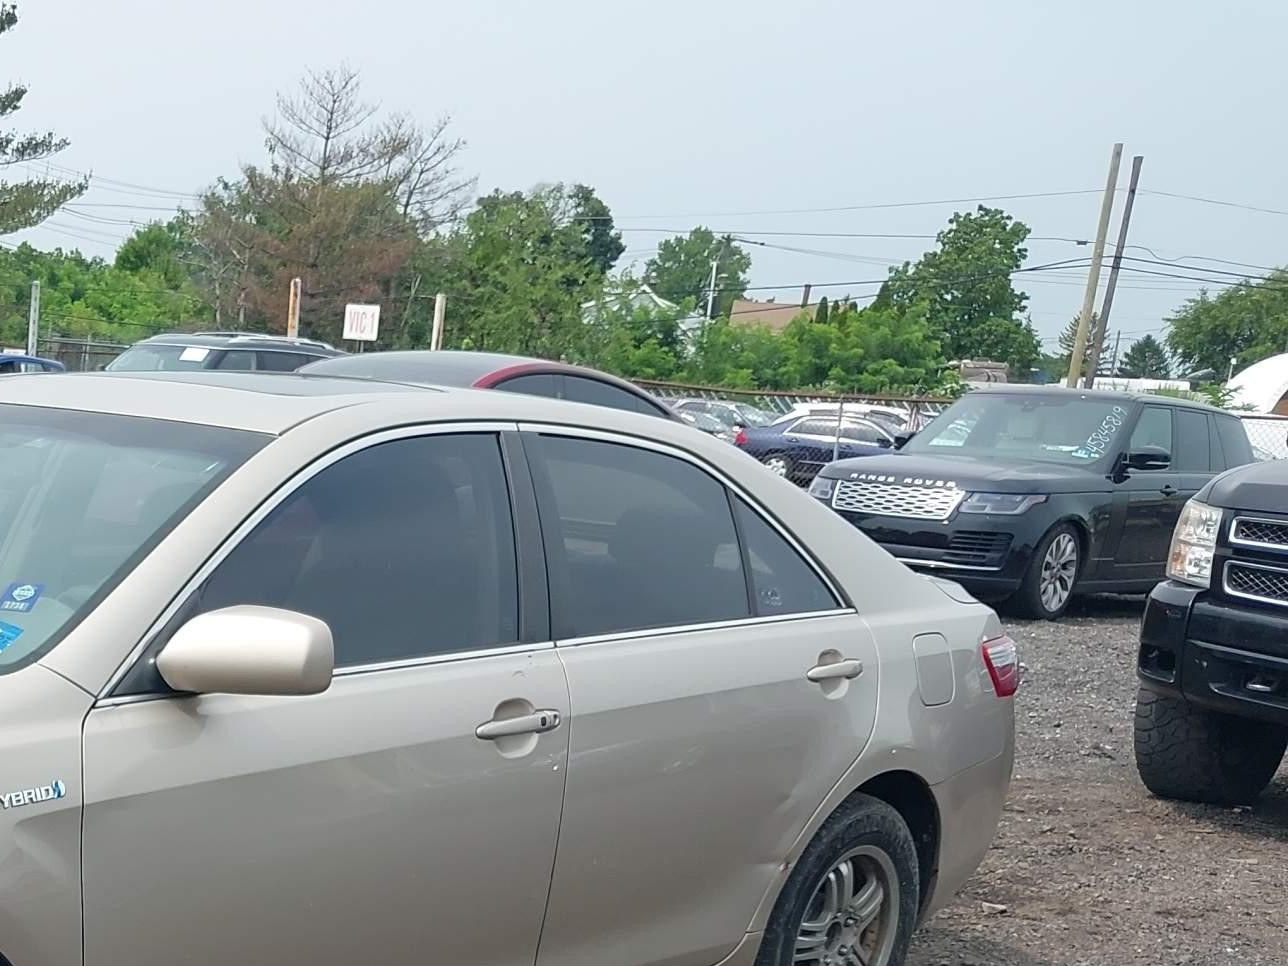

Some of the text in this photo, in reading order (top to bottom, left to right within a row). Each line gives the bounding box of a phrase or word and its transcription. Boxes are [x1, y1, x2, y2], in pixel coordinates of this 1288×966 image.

[349, 310, 376, 334] VIC 1
[849, 472, 957, 488] RANGE ROVER
